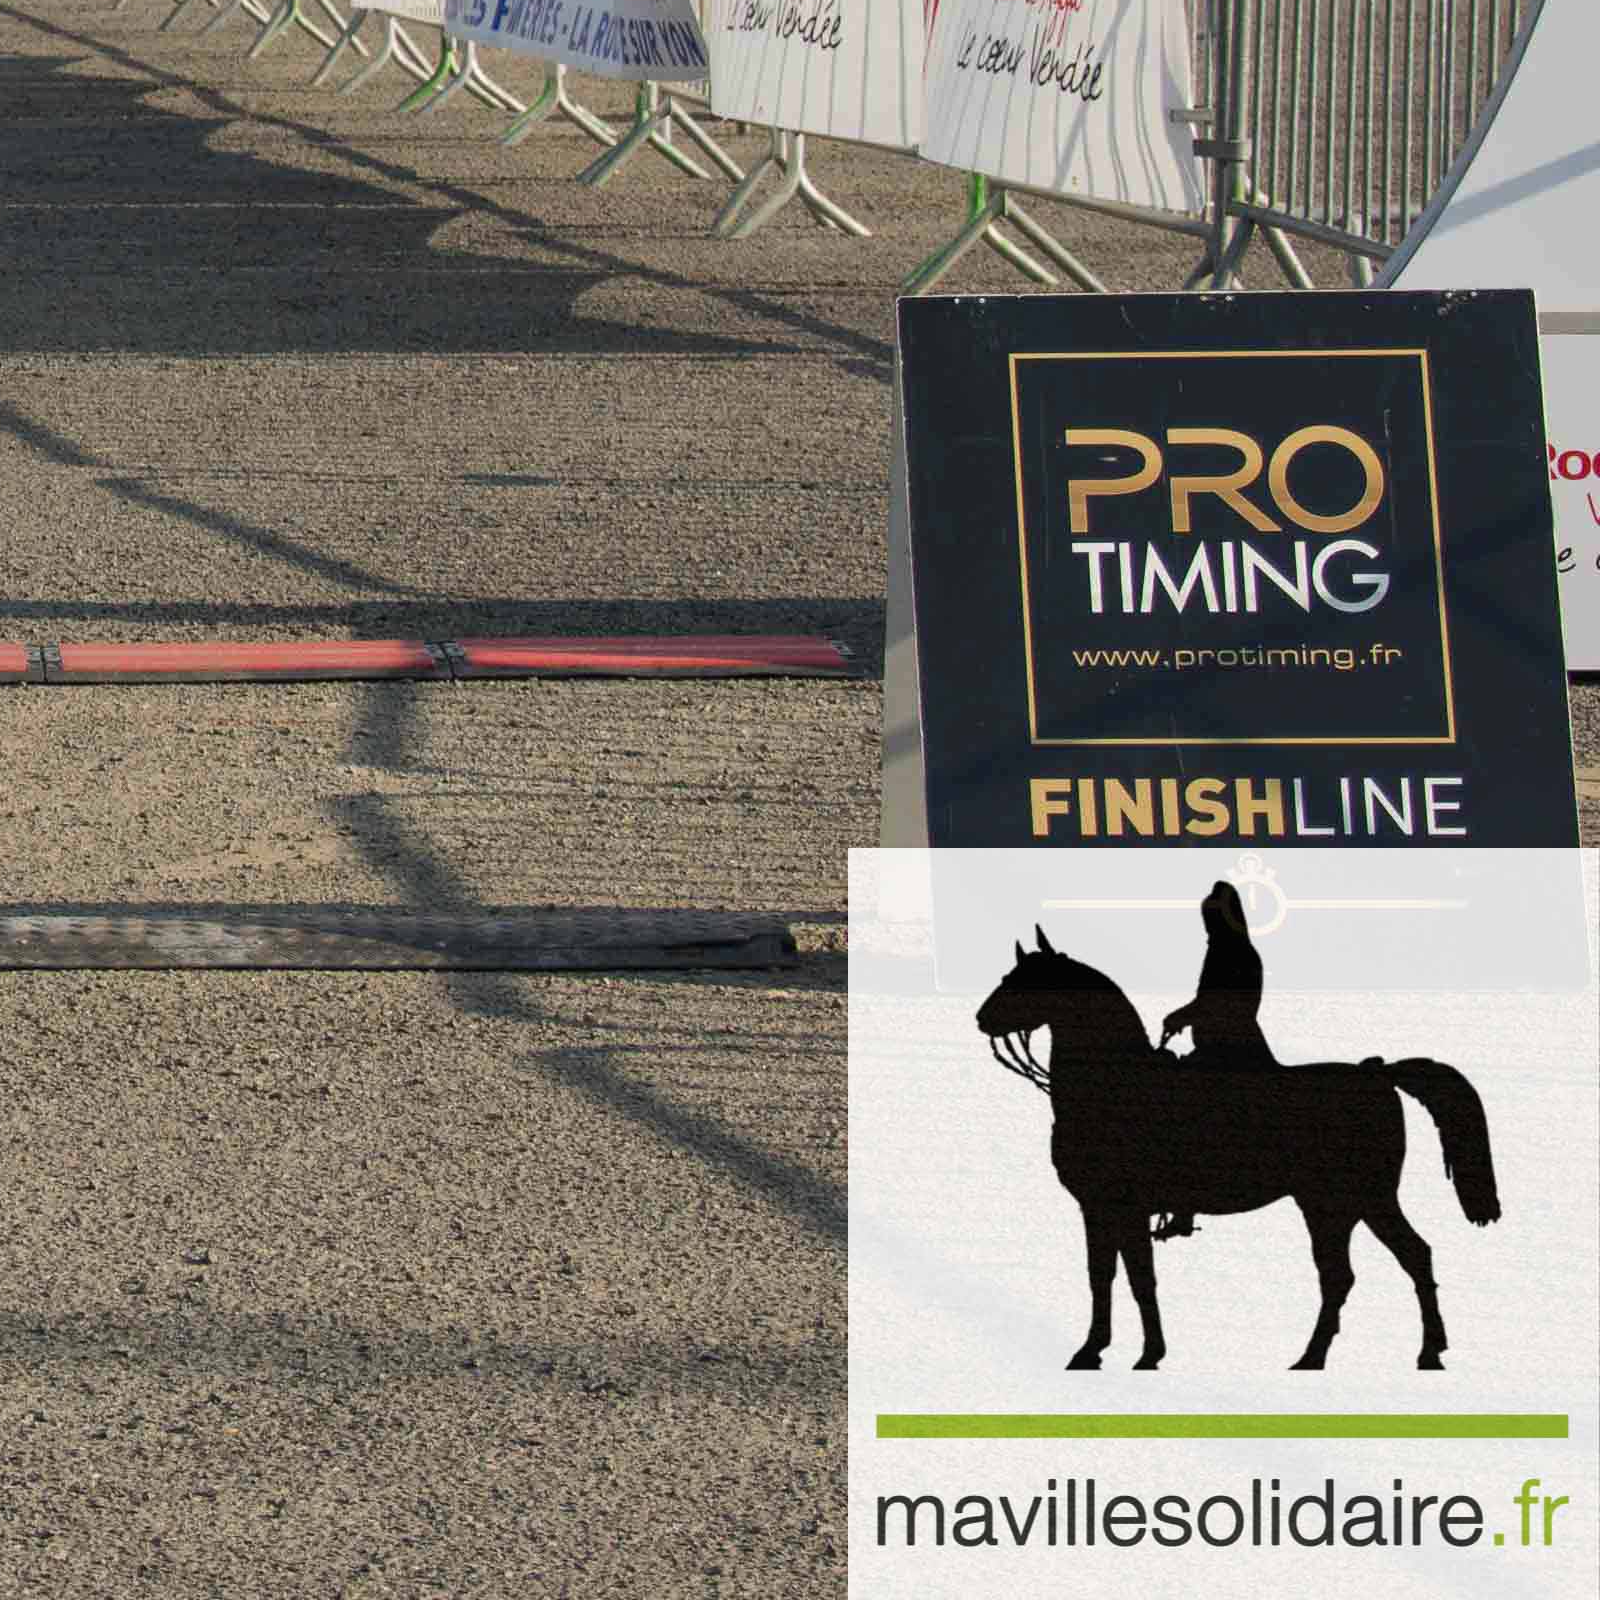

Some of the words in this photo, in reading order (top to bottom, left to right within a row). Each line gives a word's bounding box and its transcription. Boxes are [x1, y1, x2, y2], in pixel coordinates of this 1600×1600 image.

[1027, 23, 1104, 102] Vendée
[1064, 424, 1384, 533] PRO
[1071, 539, 1390, 614] TIMING
[1072, 643, 1403, 669] www.protiming.fr
[1029, 776, 1468, 837] FINISHLINE
